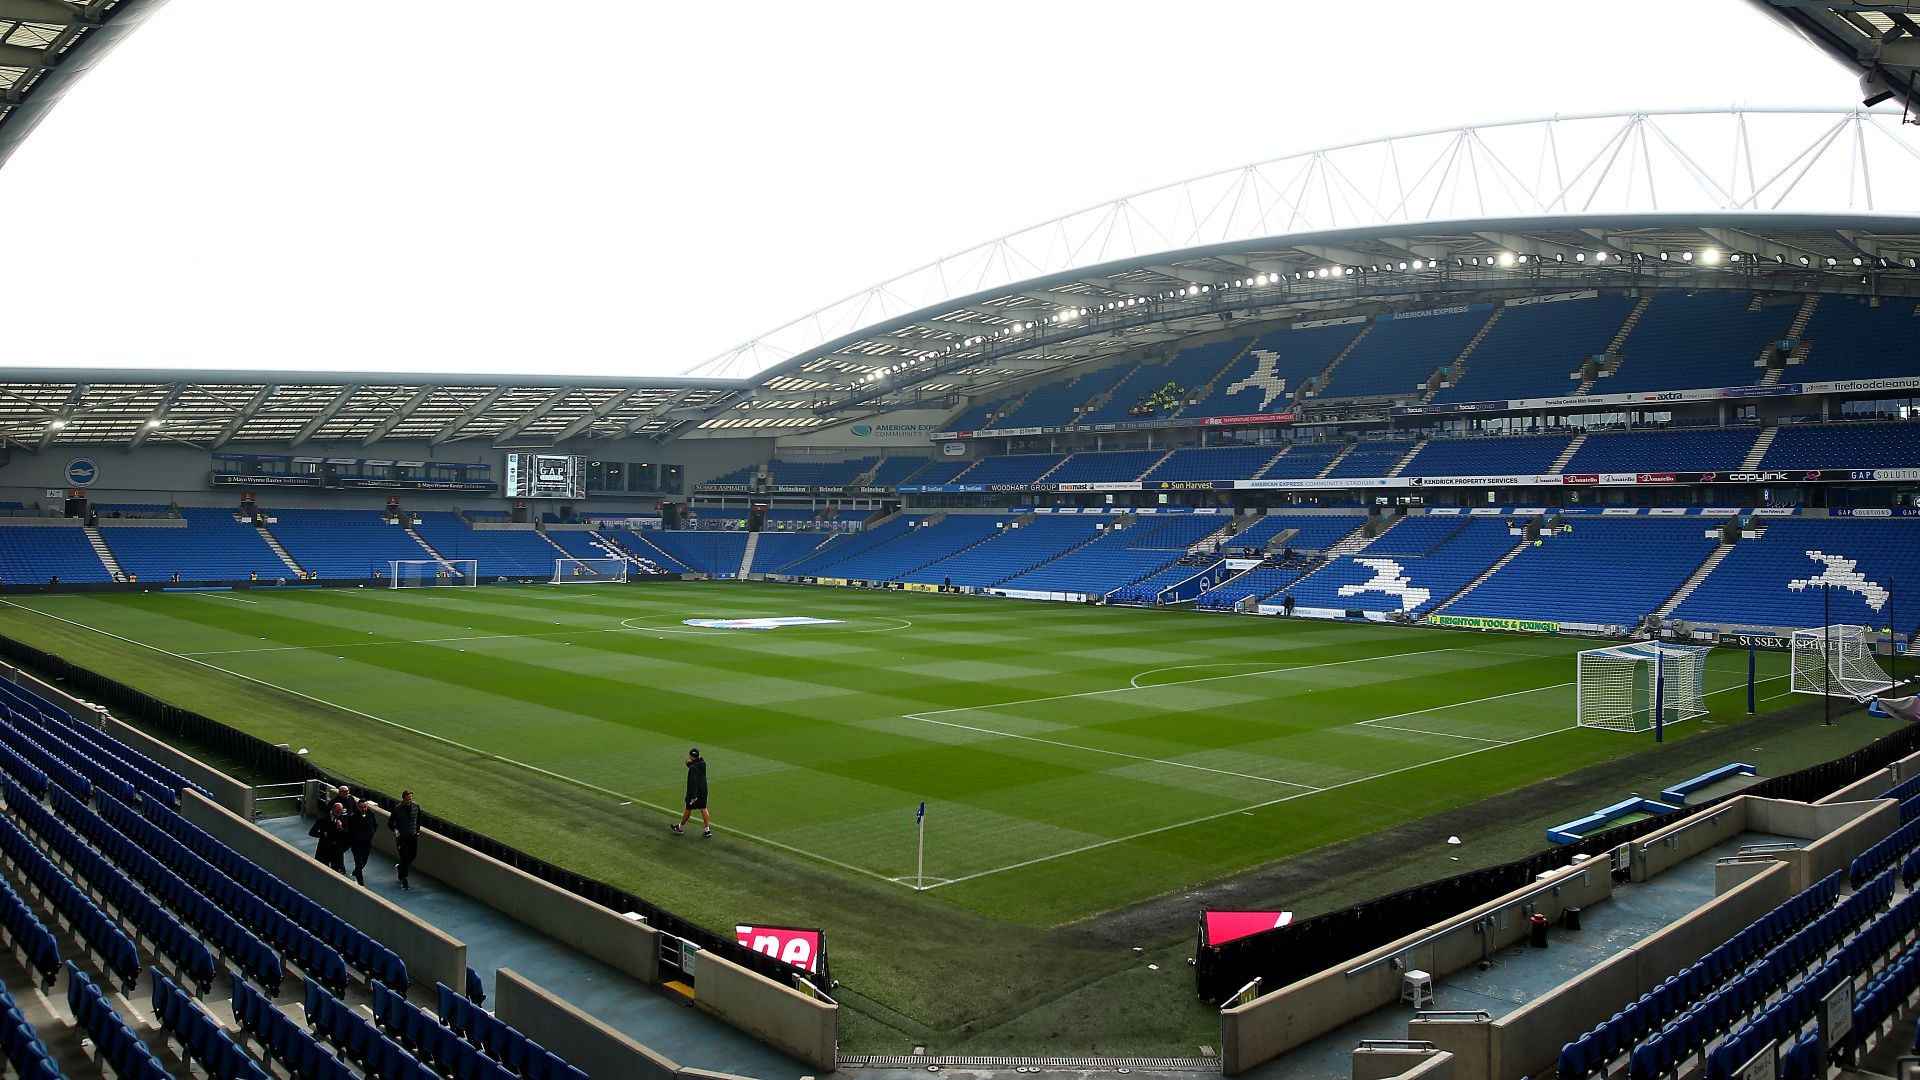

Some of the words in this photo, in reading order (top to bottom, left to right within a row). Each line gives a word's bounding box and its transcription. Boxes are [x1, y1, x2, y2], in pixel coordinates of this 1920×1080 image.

[1393, 311, 1432, 320] AMERICAN
[1433, 306, 1469, 316] EXPRESS
[1835, 380, 1919, 391] firefloodcleanup
[1657, 392, 1682, 400] axtra
[540, 467, 564, 475] GAP
[1851, 471, 1871, 480] GAP
[1565, 475, 1598, 483] Donatello
[1729, 472, 1788, 482] copylink
[1185, 481, 1213, 489] Harvest
[1440, 617, 1481, 626] BRIGHTON
[1482, 619, 1509, 629] TOOLS
[1511, 621, 1517, 629] &
[1739, 635, 1783, 648] SUSSEX
